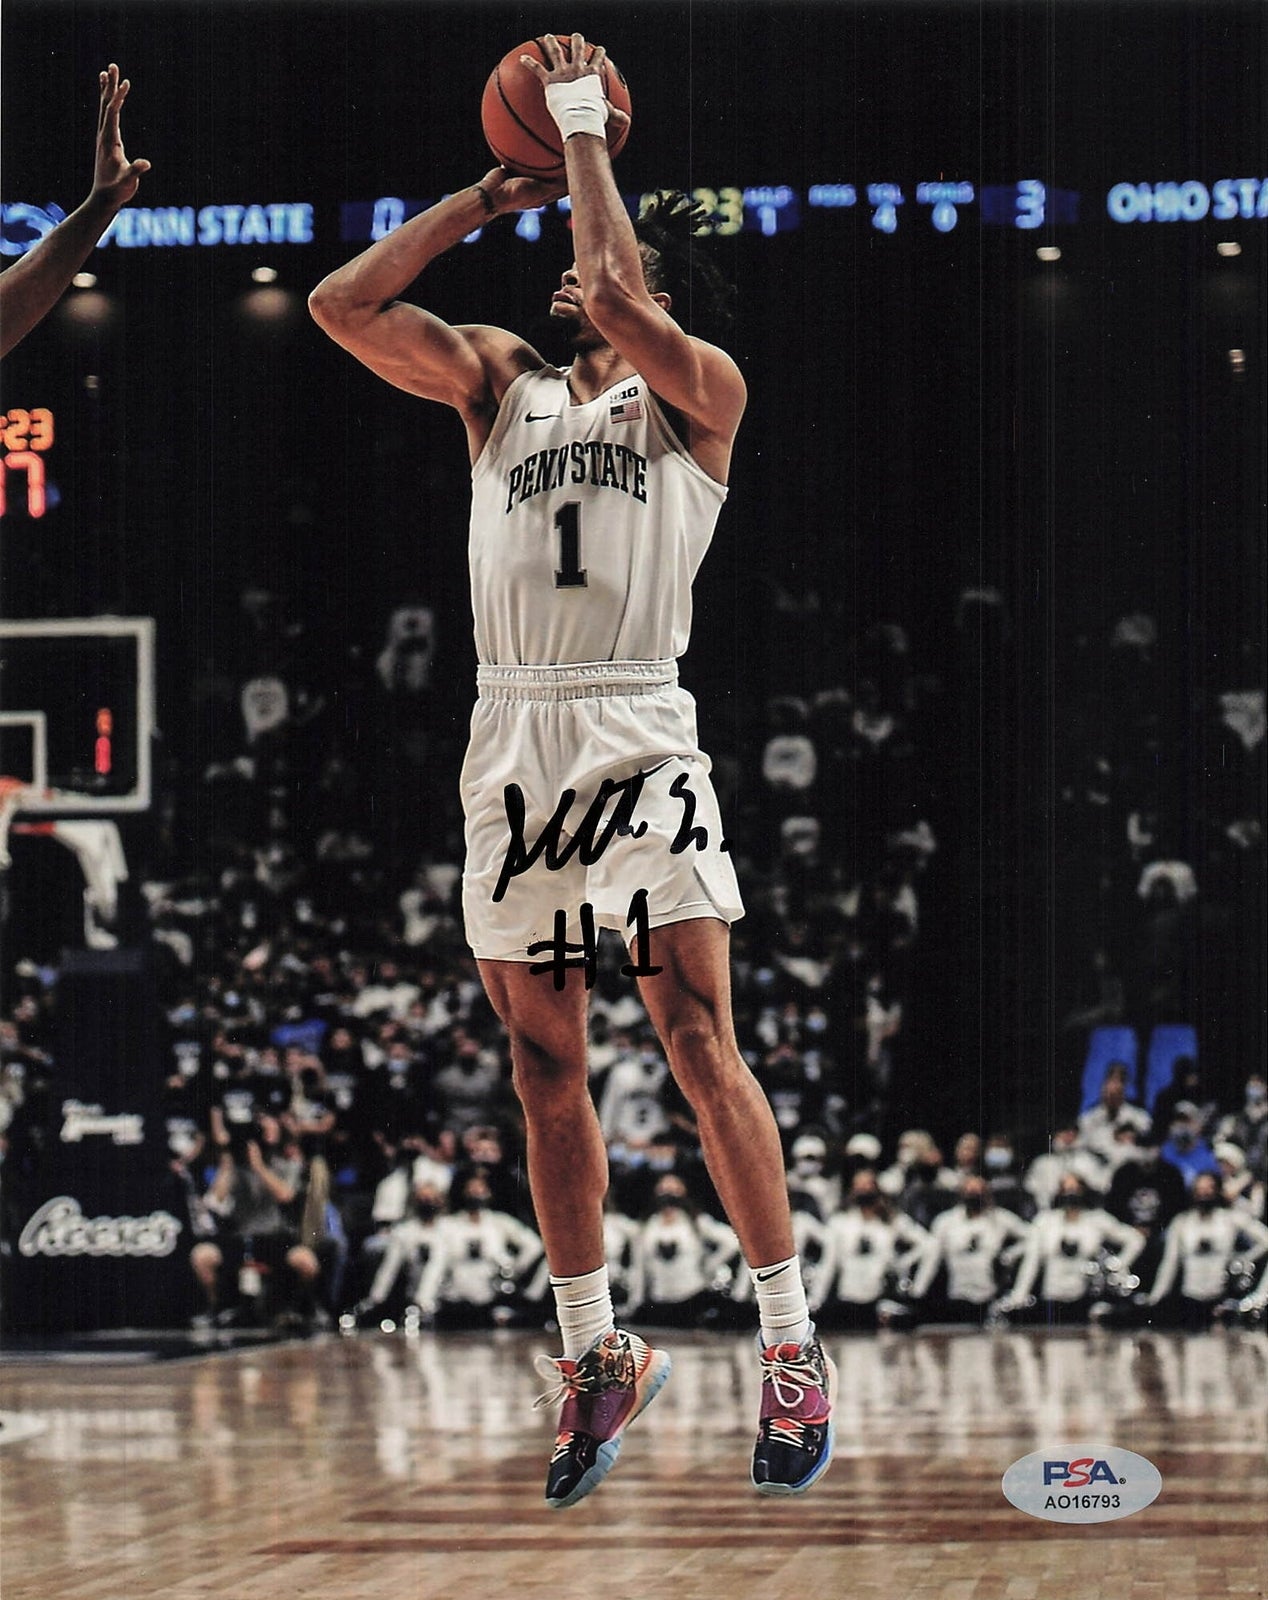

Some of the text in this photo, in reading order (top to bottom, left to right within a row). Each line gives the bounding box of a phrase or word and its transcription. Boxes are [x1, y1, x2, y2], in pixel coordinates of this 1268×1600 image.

[198, 203, 314, 245] STATE
[1015, 179, 1046, 229] 3
[1107, 180, 1210, 223] OHIO
[506, 441, 648, 515] PENN STATE
[554, 501, 588, 588] 1
[1043, 1458, 1119, 1487] PSA
